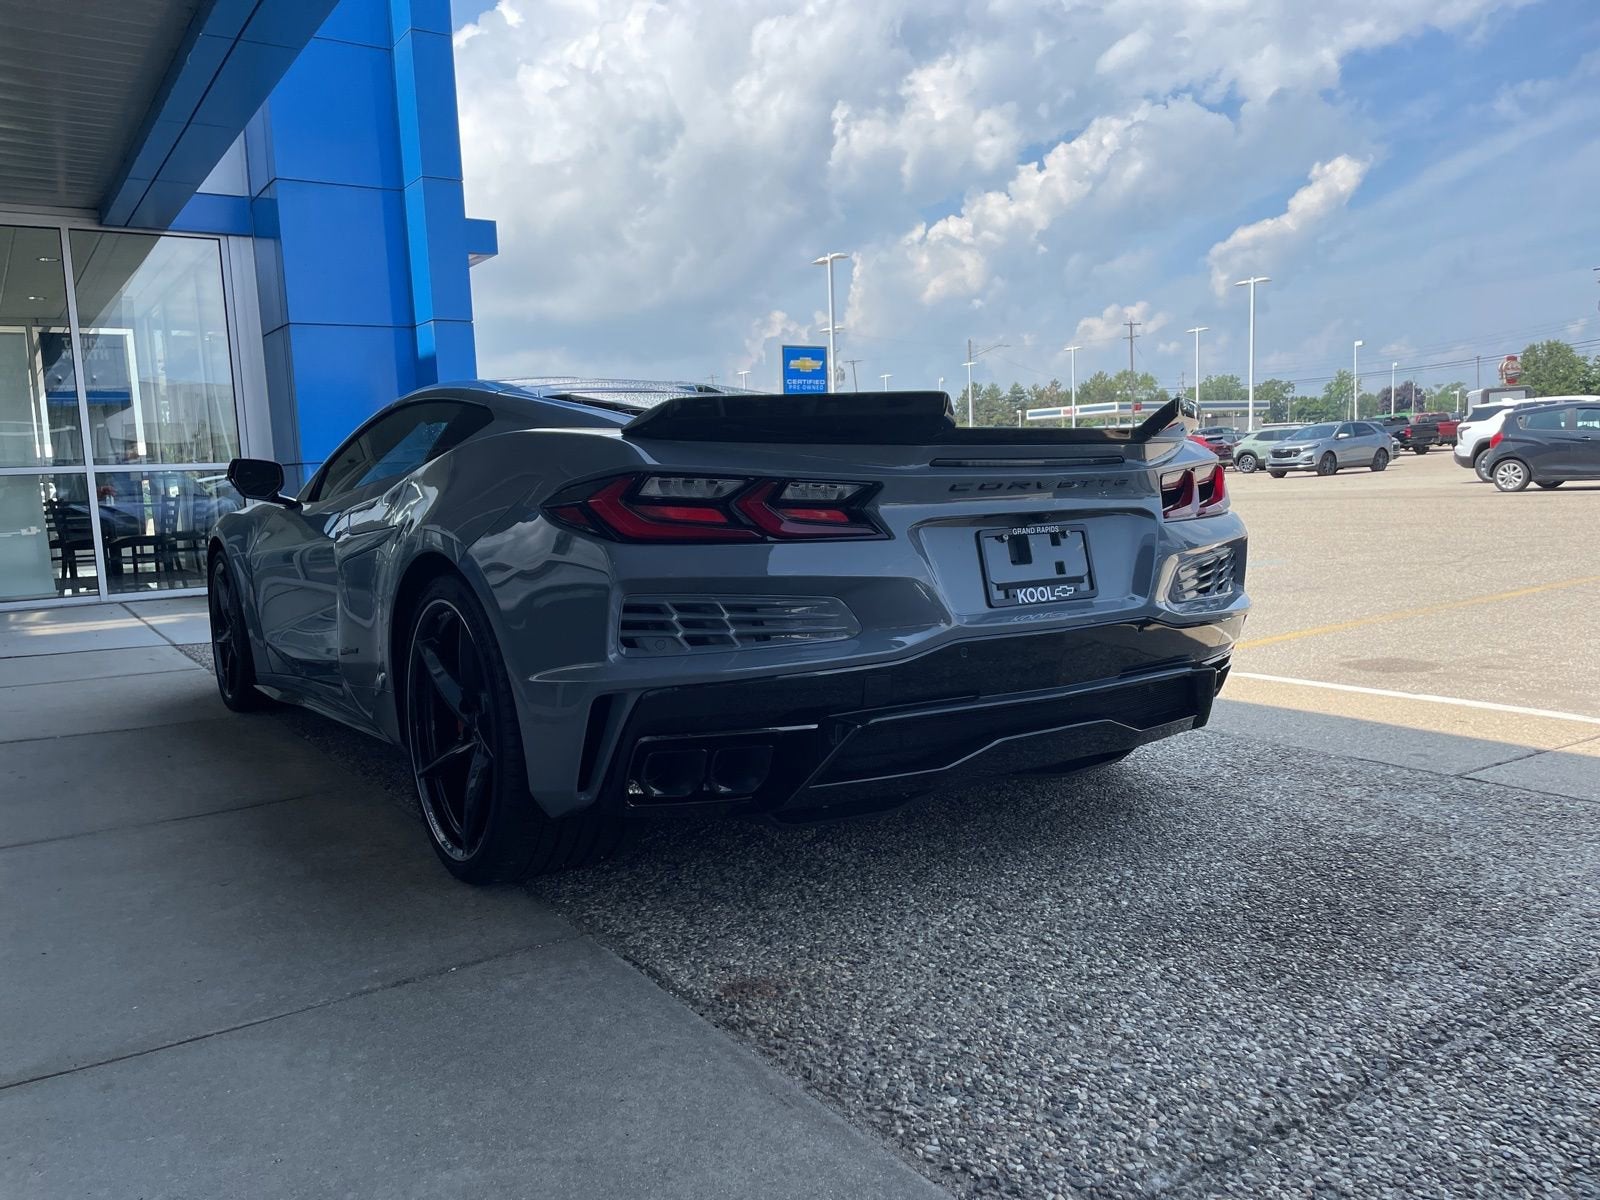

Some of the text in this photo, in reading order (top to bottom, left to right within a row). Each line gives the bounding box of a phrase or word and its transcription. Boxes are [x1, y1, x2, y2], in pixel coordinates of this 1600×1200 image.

[949, 479, 1129, 492] CORVETTE
[1012, 525, 1060, 535] GRAND RAPIDS
[1016, 586, 1057, 604] KOOL
